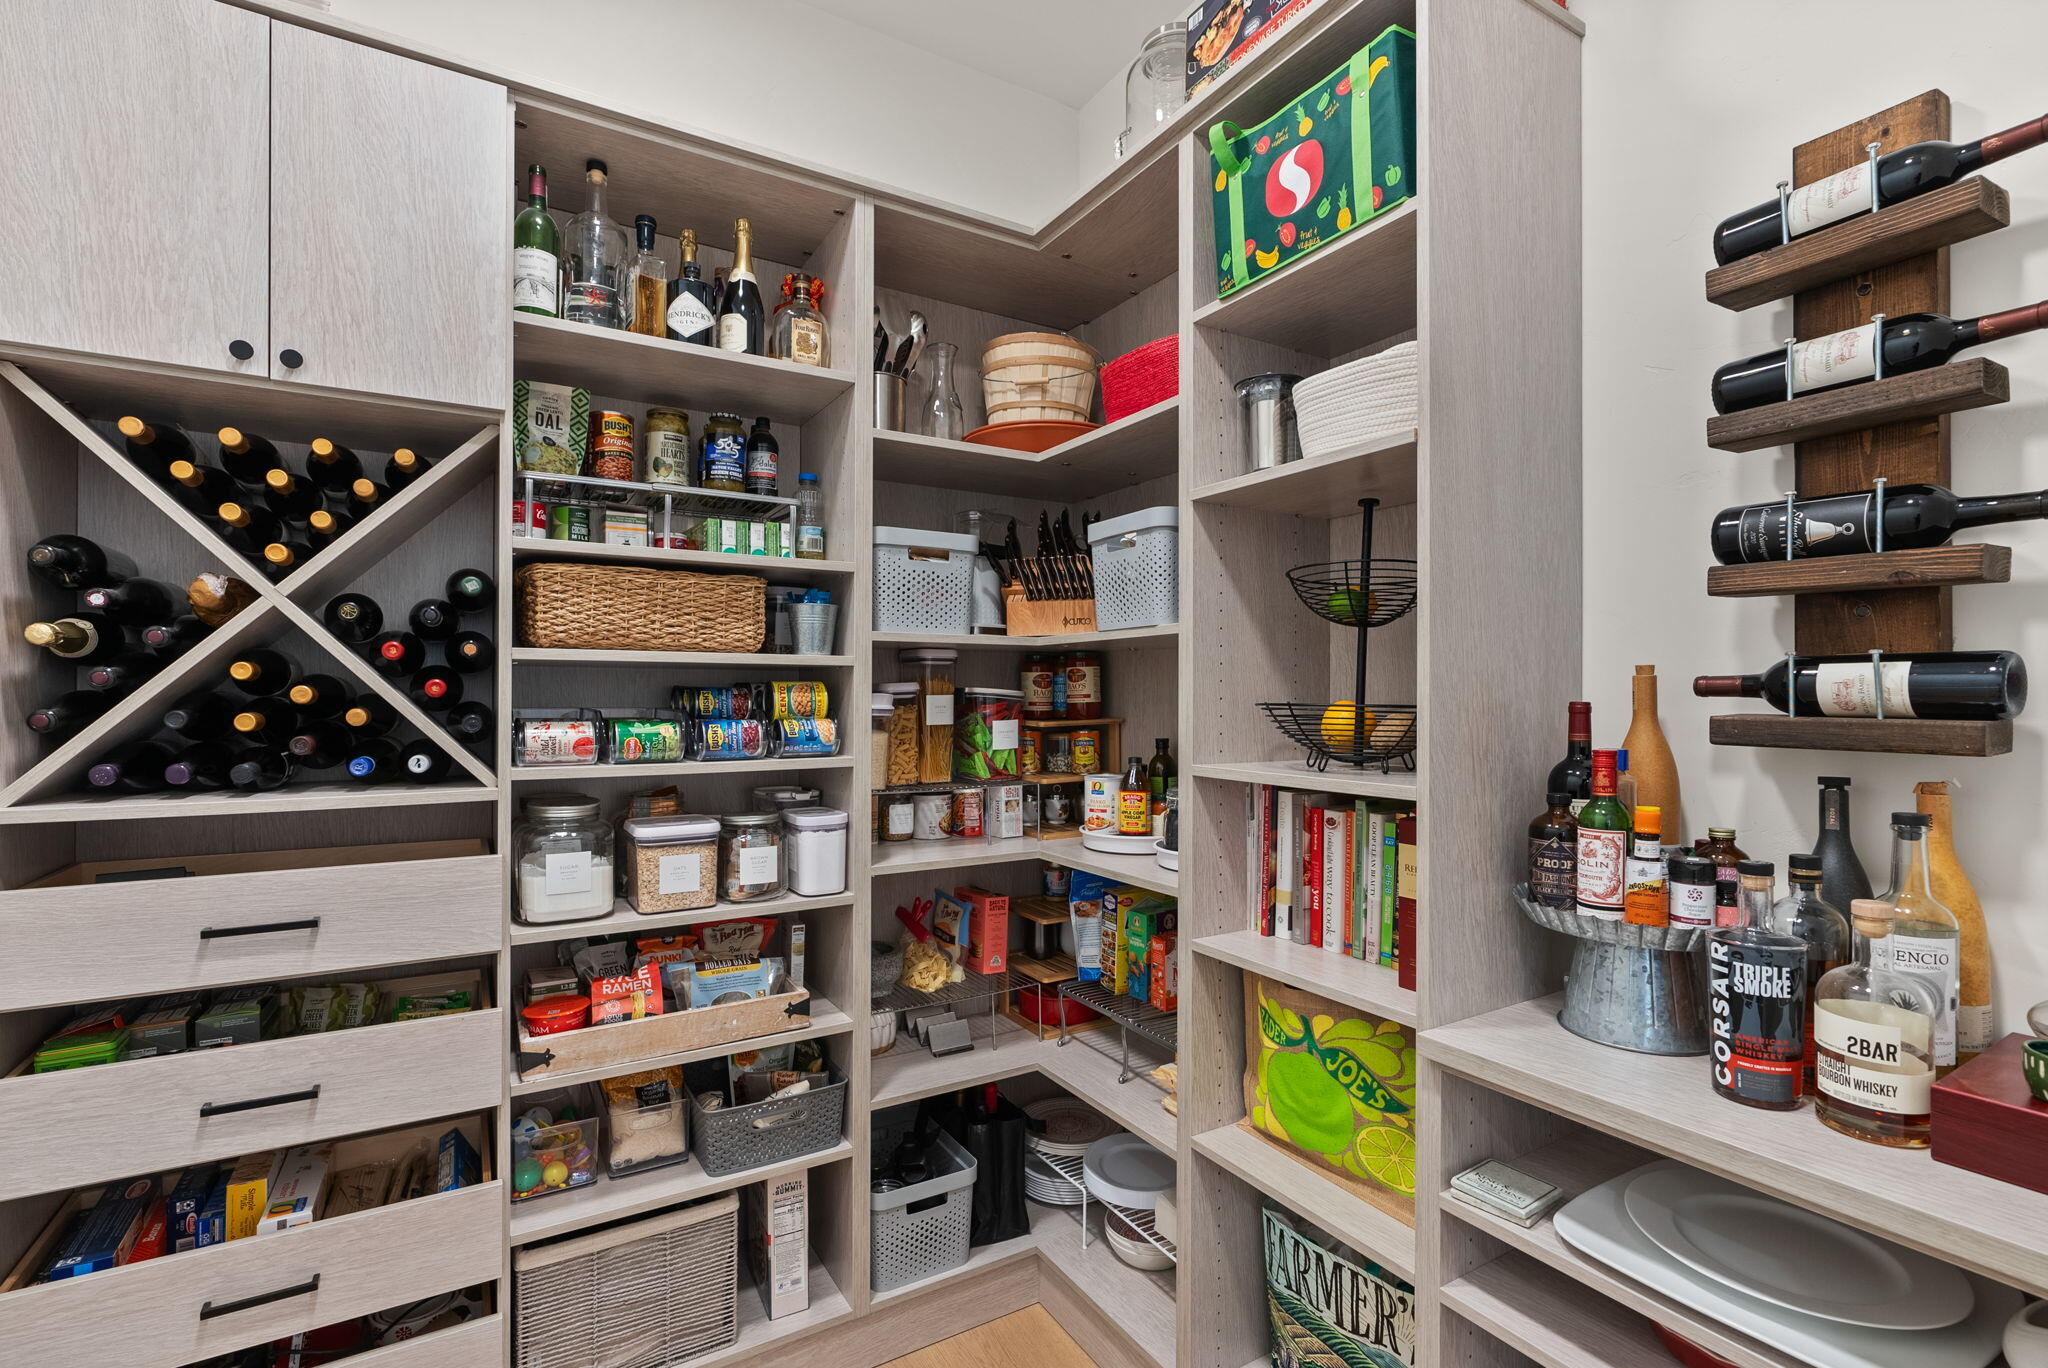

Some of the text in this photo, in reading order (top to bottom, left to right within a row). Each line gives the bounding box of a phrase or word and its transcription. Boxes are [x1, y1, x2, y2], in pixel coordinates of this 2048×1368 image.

[1299, 230, 1313, 240] fruit
[1297, 237, 1320, 250] veggies
[679, 319, 696, 327] GIN
[535, 411, 563, 431] DAL
[604, 420, 632, 435] BUSH'S
[660, 448, 685, 461] HEARTS
[1068, 617, 1092, 627] CUTCO
[702, 690, 711, 714] BUSH'S
[710, 724, 718, 750] BUSH'S
[1312, 861, 1321, 910] plantyou
[1325, 866, 1336, 937] way to cook
[704, 958, 732, 970] ROLLED
[1895, 950, 1949, 965] ENCIO
[598, 963, 628, 978] GREEN
[731, 965, 748, 973] GRAIN
[1732, 961, 1791, 987] TRIPLE
[602, 979, 652, 994] RAMEN
[1733, 976, 1792, 999] SMOKE
[304, 1013, 323, 1021] GREEN
[1710, 941, 1732, 1086] CORSAIR
[1261, 1007, 1287, 1046] ADER
[200, 1036, 233, 1047] Nutrition Facts
[1735, 1041, 1774, 1053] SINGLE
[1734, 1048, 1784, 1060] WHISKEY
[1847, 1036, 1898, 1063] 2BAR
[1818, 1052, 1851, 1076] STRAIGHT
[1326, 1050, 1391, 1111] JOE'S
[1818, 1064, 1851, 1089] BOURBON
[1853, 1078, 1898, 1098] WHISKEY
[775, 1184, 803, 1196] SUMMIT
[248, 1187, 256, 1212] Simple
[1264, 1213, 1415, 1358] FARMER'
